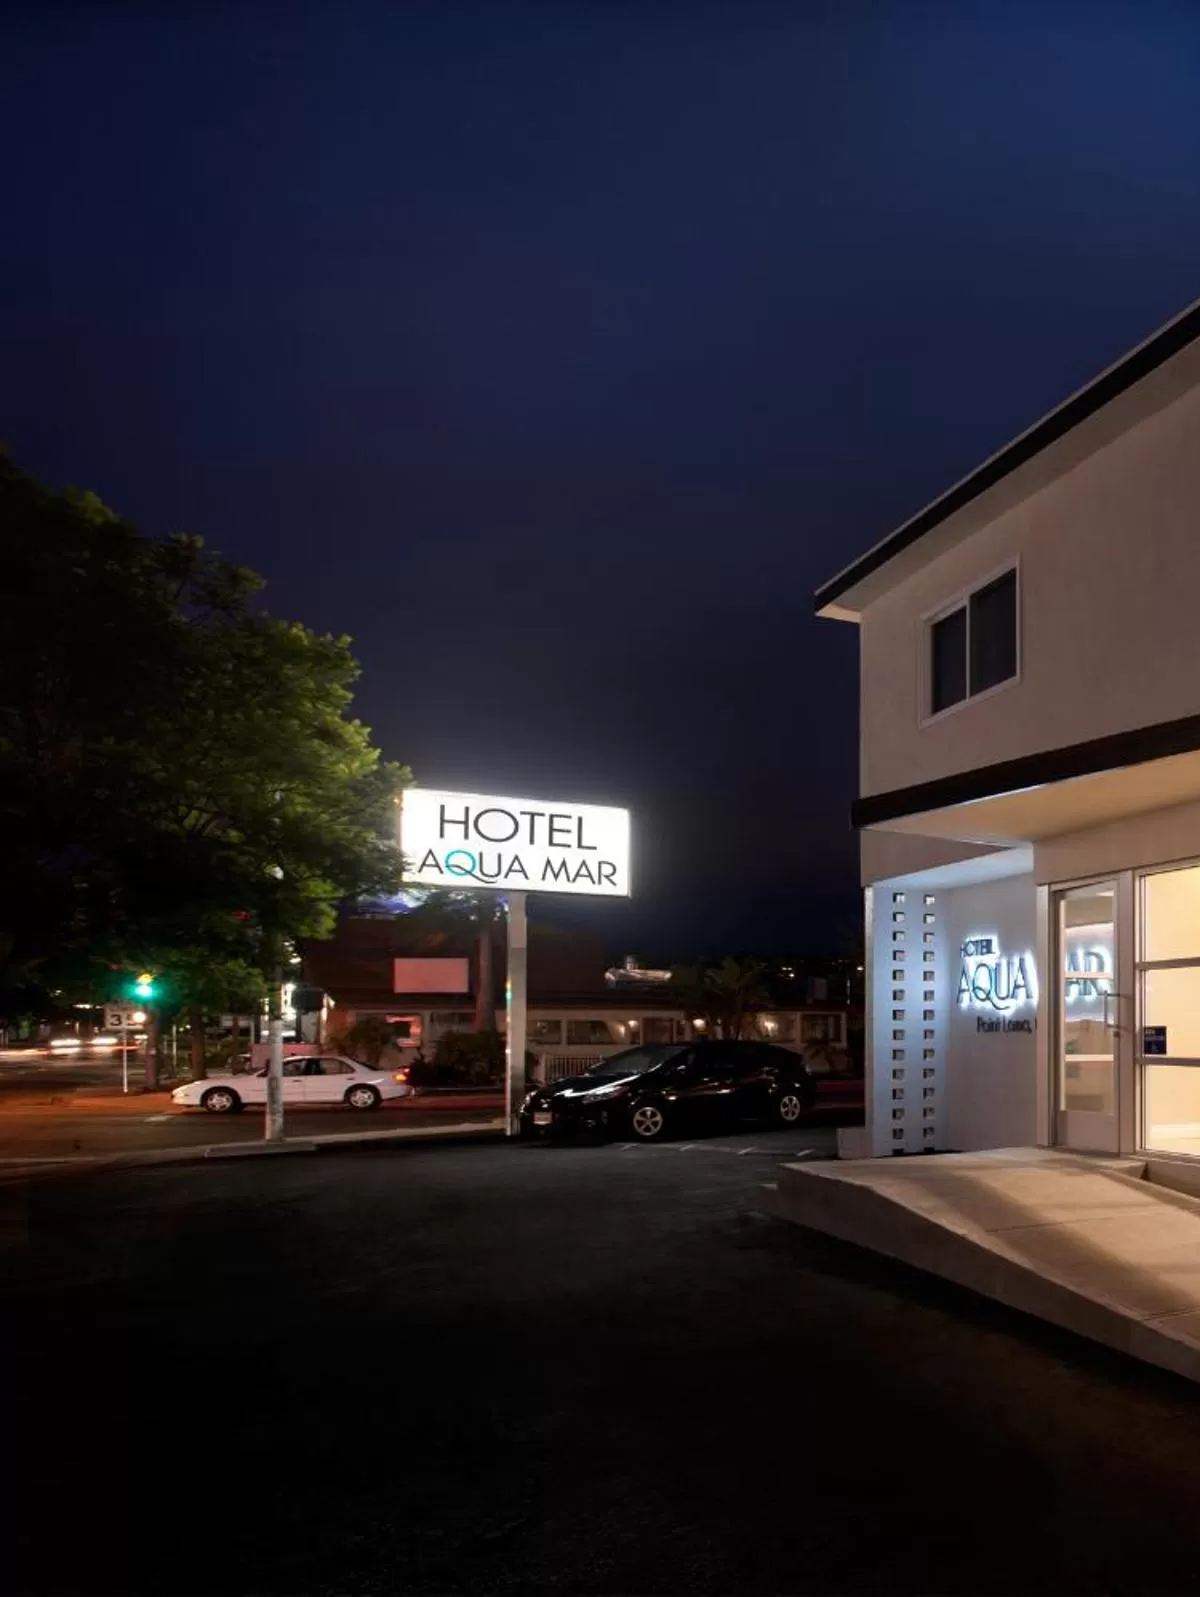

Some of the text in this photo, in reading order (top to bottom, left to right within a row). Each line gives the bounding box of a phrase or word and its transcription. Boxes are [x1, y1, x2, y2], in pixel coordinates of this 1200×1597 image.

[439, 804, 597, 850] HOTEL
[417, 848, 617, 886] AQUA MAR
[956, 957, 1034, 1011] AQUA
